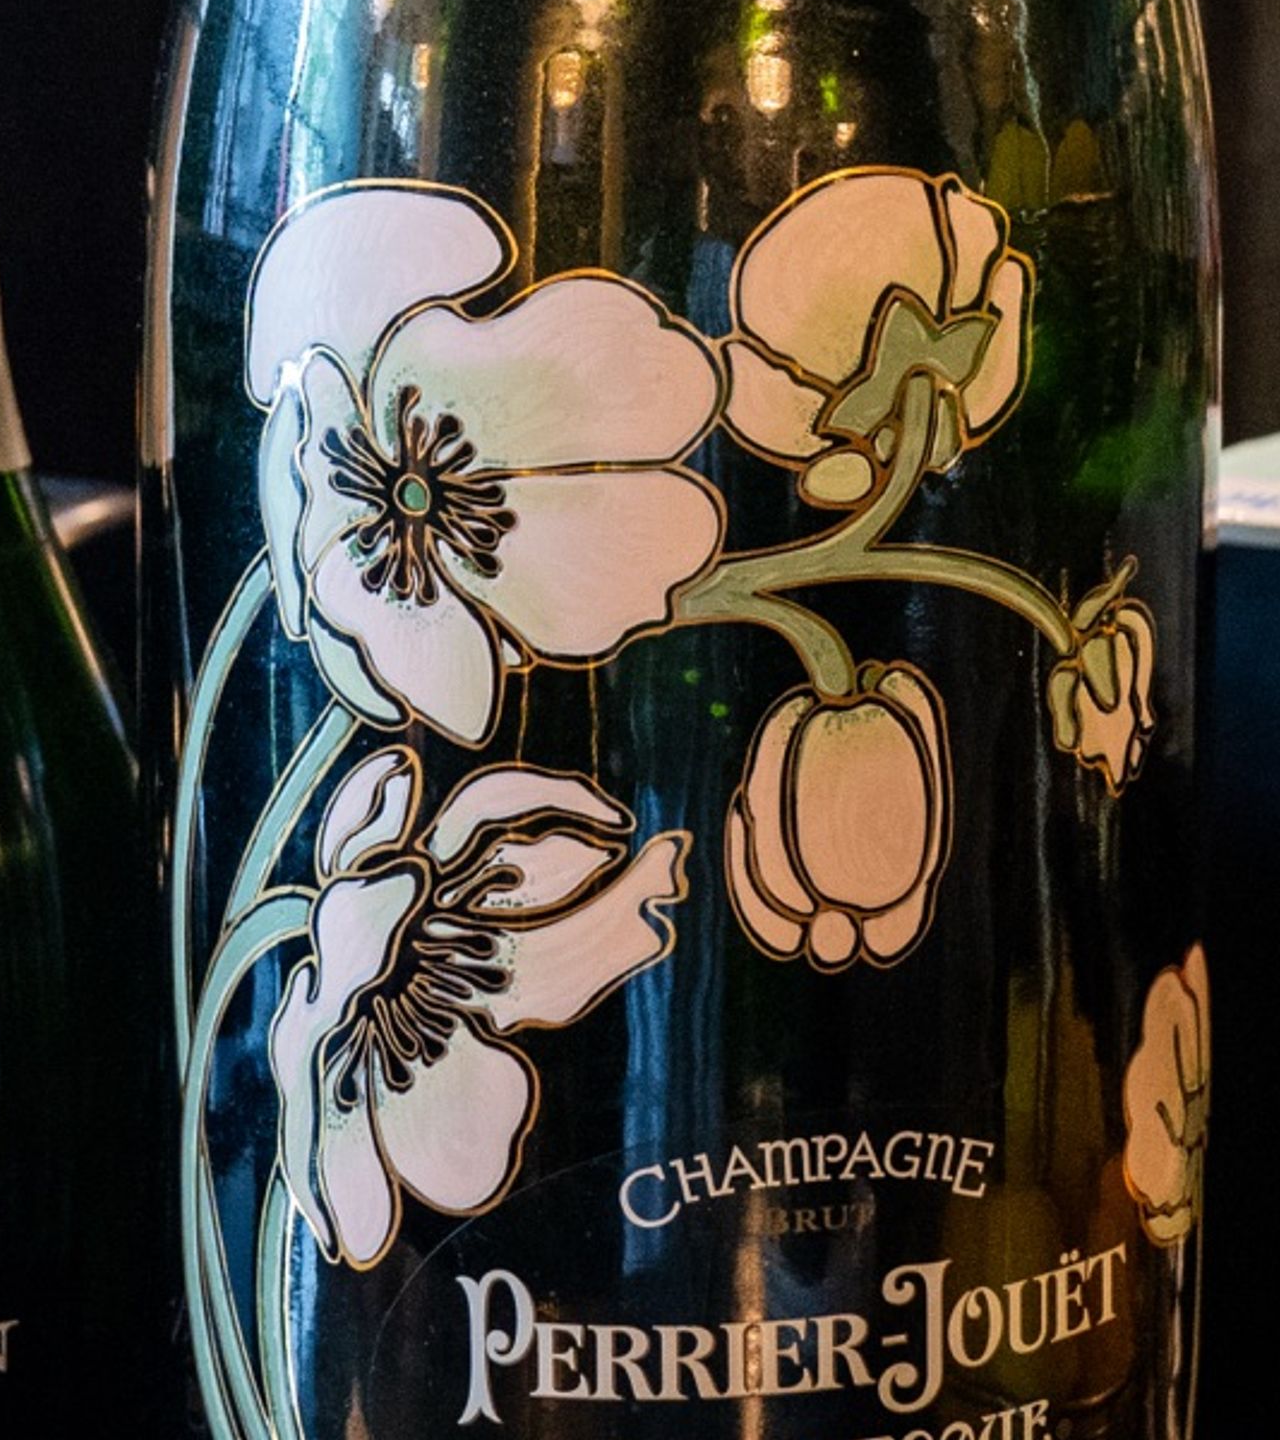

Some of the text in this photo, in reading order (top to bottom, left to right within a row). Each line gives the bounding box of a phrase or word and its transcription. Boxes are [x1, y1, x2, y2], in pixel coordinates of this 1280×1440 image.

[618, 1130, 995, 1230] CHAMPAGNE
[766, 1201, 876, 1236] BRUT
[456, 1244, 1128, 1426] PERRIER-JOUËT
